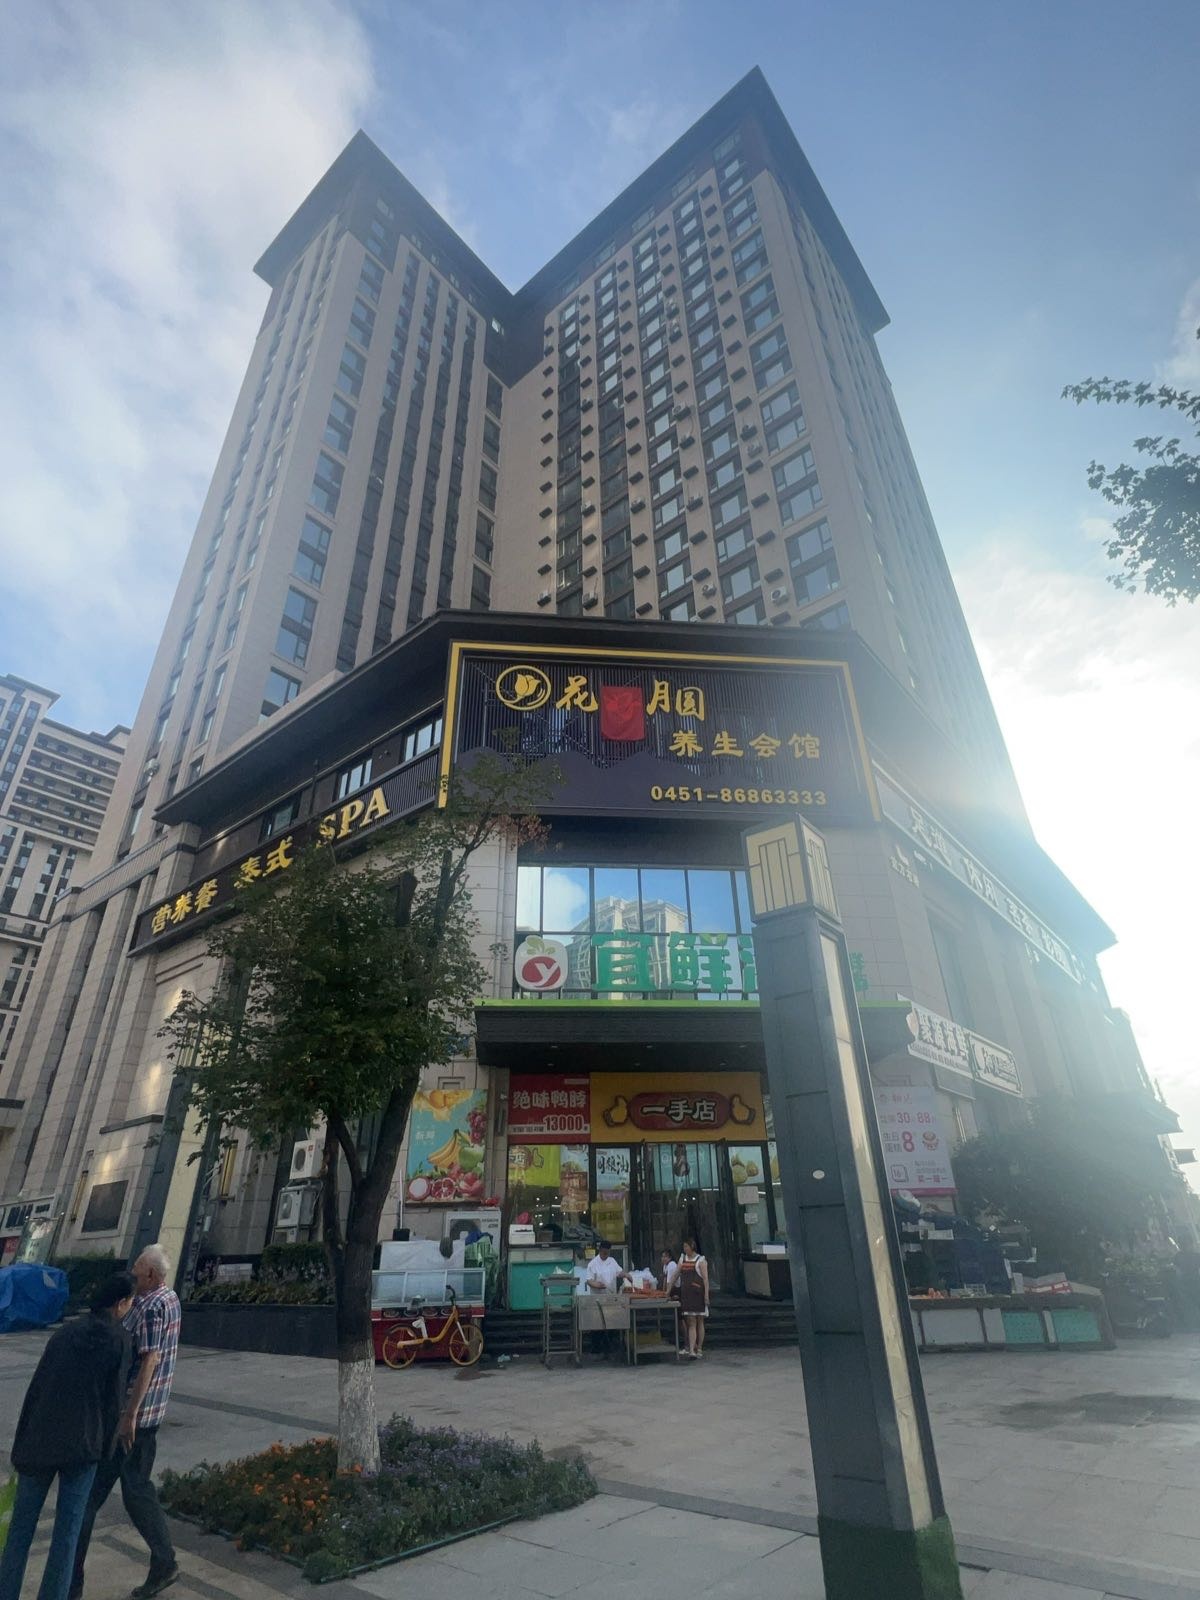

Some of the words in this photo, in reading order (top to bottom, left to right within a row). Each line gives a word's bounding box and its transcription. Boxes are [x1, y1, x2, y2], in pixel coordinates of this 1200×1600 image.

[556, 675, 705, 721] 花月圆
[668, 729, 821, 760] 养生会馆
[650, 785, 827, 806] 0451-86863333
[151, 878, 218, 935] 营养餐
[316, 786, 391, 849] SPA
[512, 1090, 587, 1110] 绝味鸭脖
[641, 1099, 717, 1122] 一手店
[543, 1115, 583, 1132] 13000
